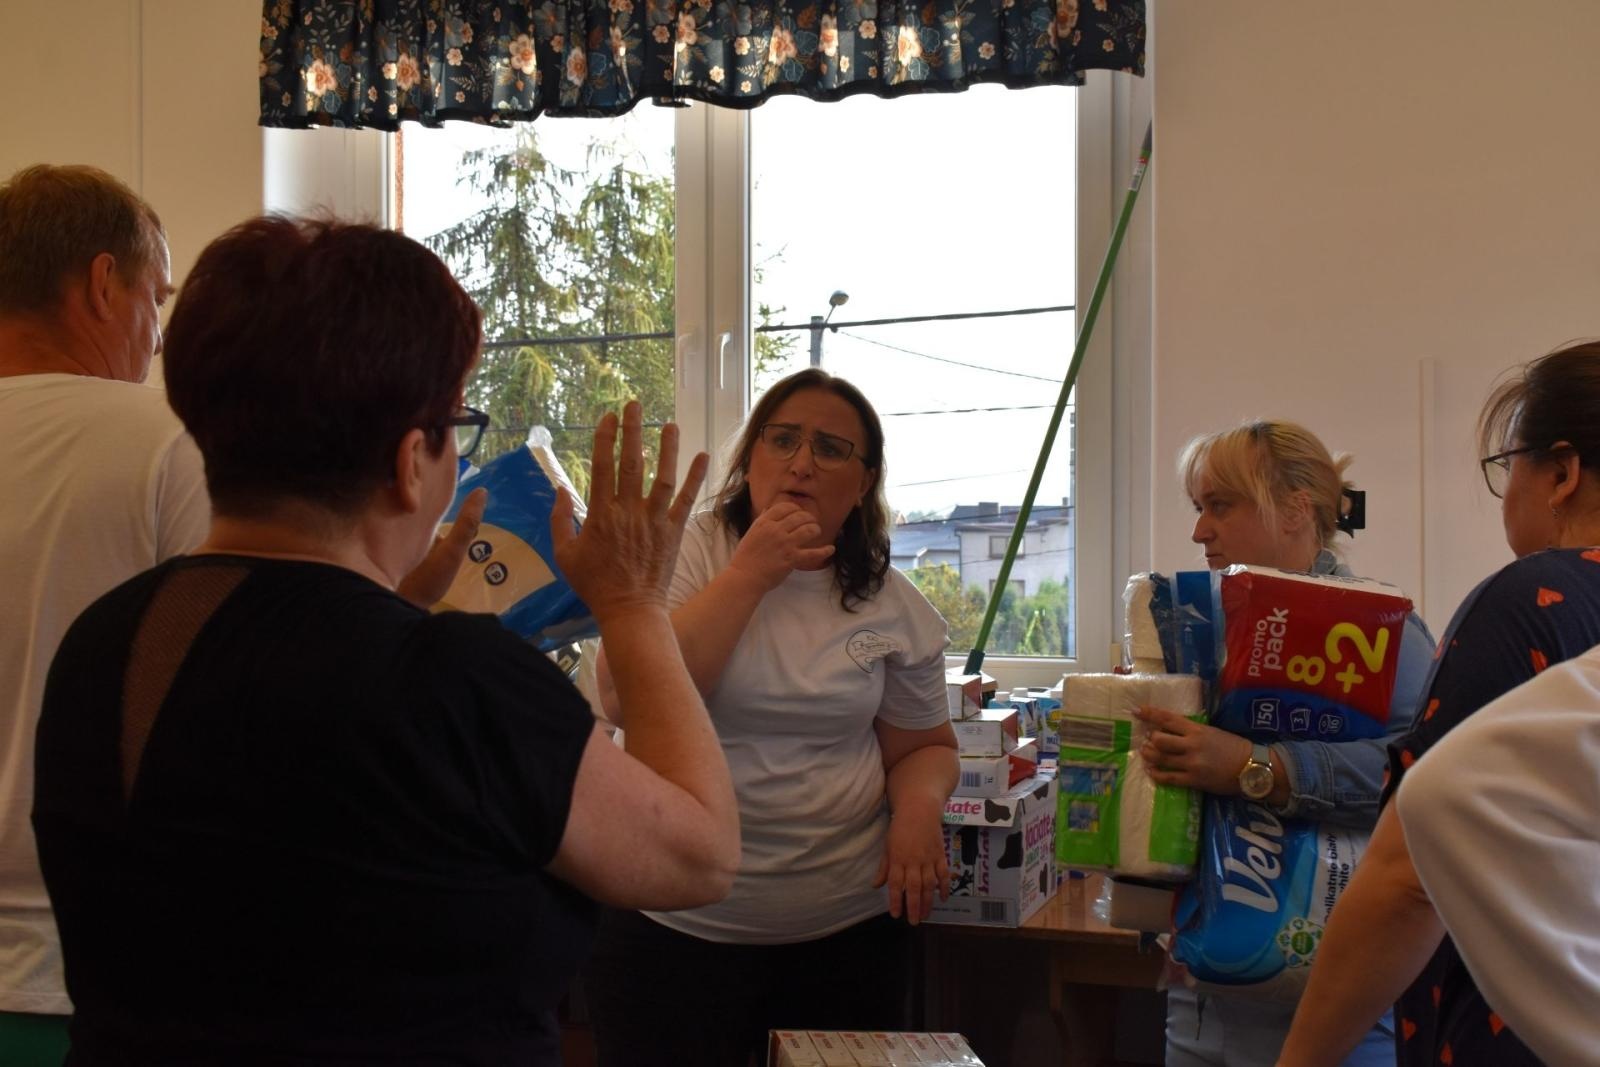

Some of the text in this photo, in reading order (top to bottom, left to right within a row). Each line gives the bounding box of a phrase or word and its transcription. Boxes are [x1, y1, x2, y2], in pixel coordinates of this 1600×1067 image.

[1247, 620, 1268, 677] promo
[1263, 607, 1289, 671] pack
[1256, 702, 1275, 726] 150
[1293, 717, 1304, 725] 3
[943, 800, 982, 815] iate
